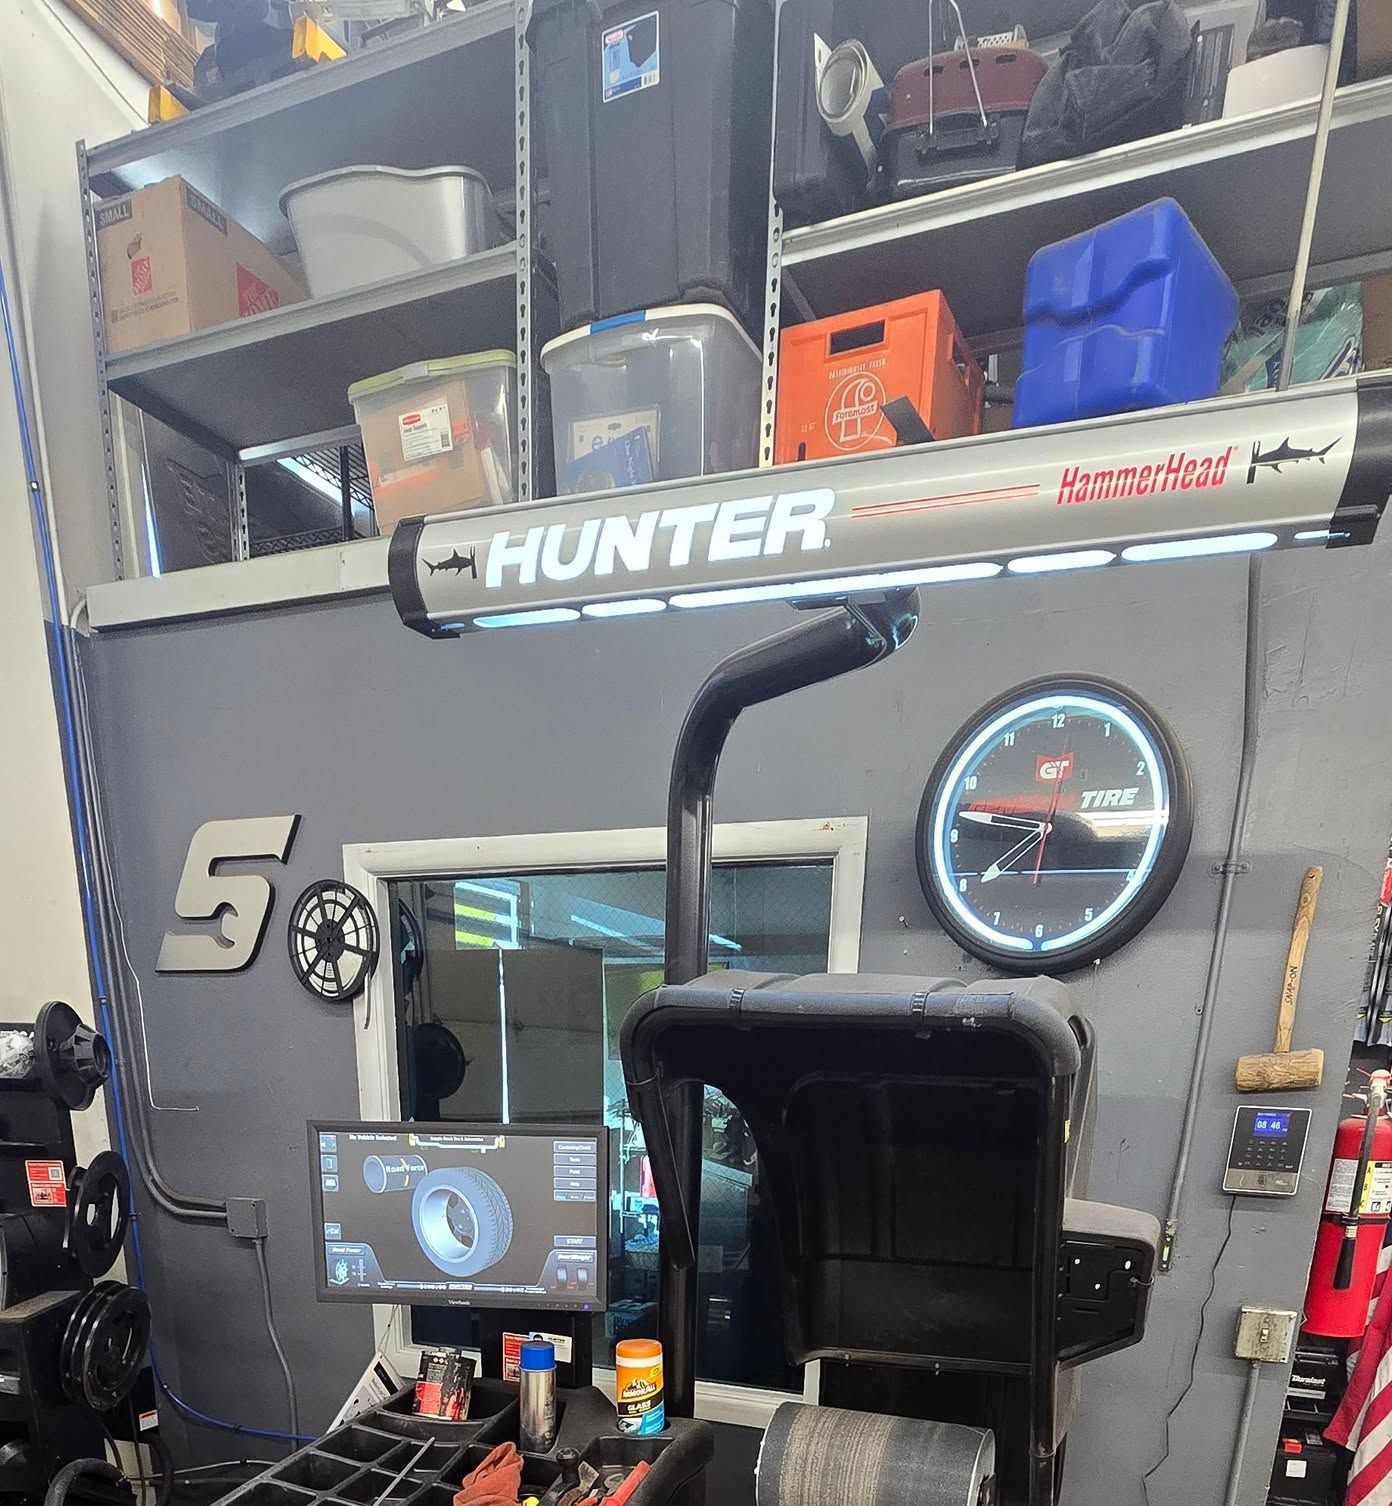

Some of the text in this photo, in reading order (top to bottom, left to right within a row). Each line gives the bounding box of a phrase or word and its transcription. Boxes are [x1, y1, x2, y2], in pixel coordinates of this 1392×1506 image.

[99, 201, 129, 226] SMALL
[1056, 446, 1233, 505] HammerHead
[485, 488, 836, 589] HUNTER
[1051, 713, 1066, 729] 12
[1103, 722, 1112, 738] 1
[1003, 732, 1016, 747] 11
[1039, 759, 1070, 780] GT
[1136, 761, 1146, 777] 2
[964, 775, 978, 791] 10
[1080, 787, 1140, 809] TIRE
[950, 828, 959, 843] 9
[959, 877, 968, 893] 8
[993, 910, 1002, 926] 7
[1084, 907, 1094, 922] 5
[1035, 924, 1043, 939] 6
[1284, 965, 1298, 1006] SNAP-ON
[385, 1164, 425, 1173] Road Force
[627, 1399, 652, 1412] GLASS
